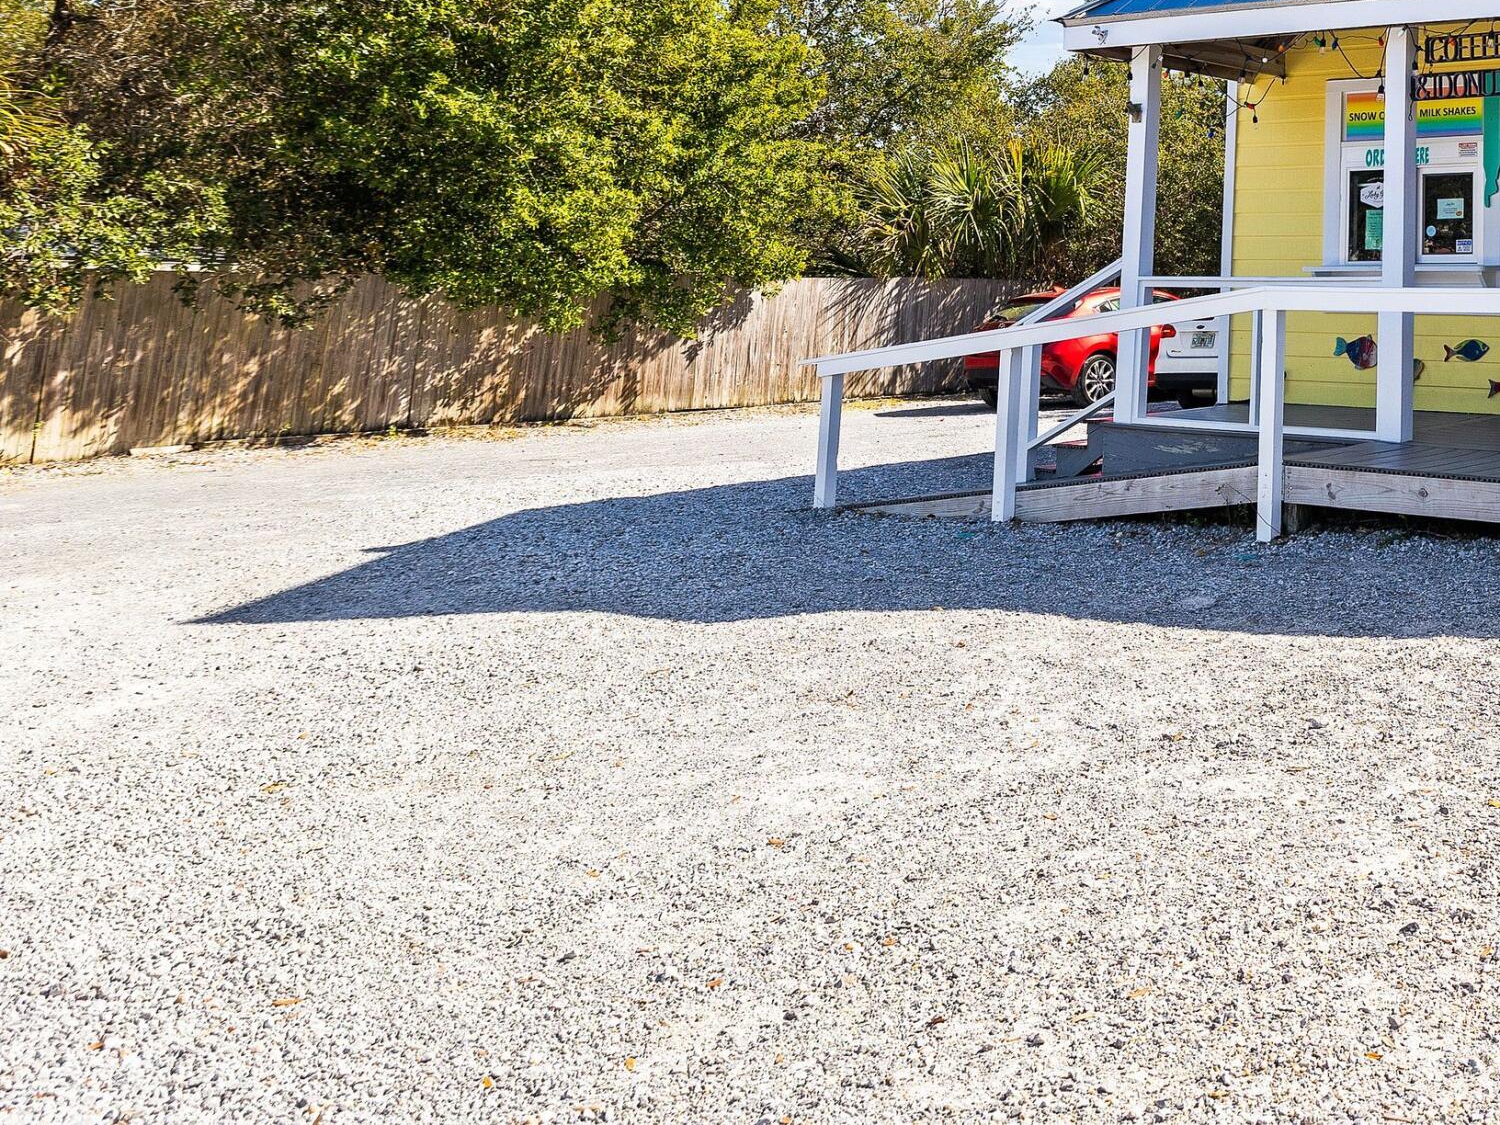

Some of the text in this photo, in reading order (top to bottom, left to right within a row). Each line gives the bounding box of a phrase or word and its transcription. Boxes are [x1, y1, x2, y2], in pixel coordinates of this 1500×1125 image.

[1349, 111, 1377, 122] SNOW
[1419, 106, 1476, 118] MILK SHAKES
